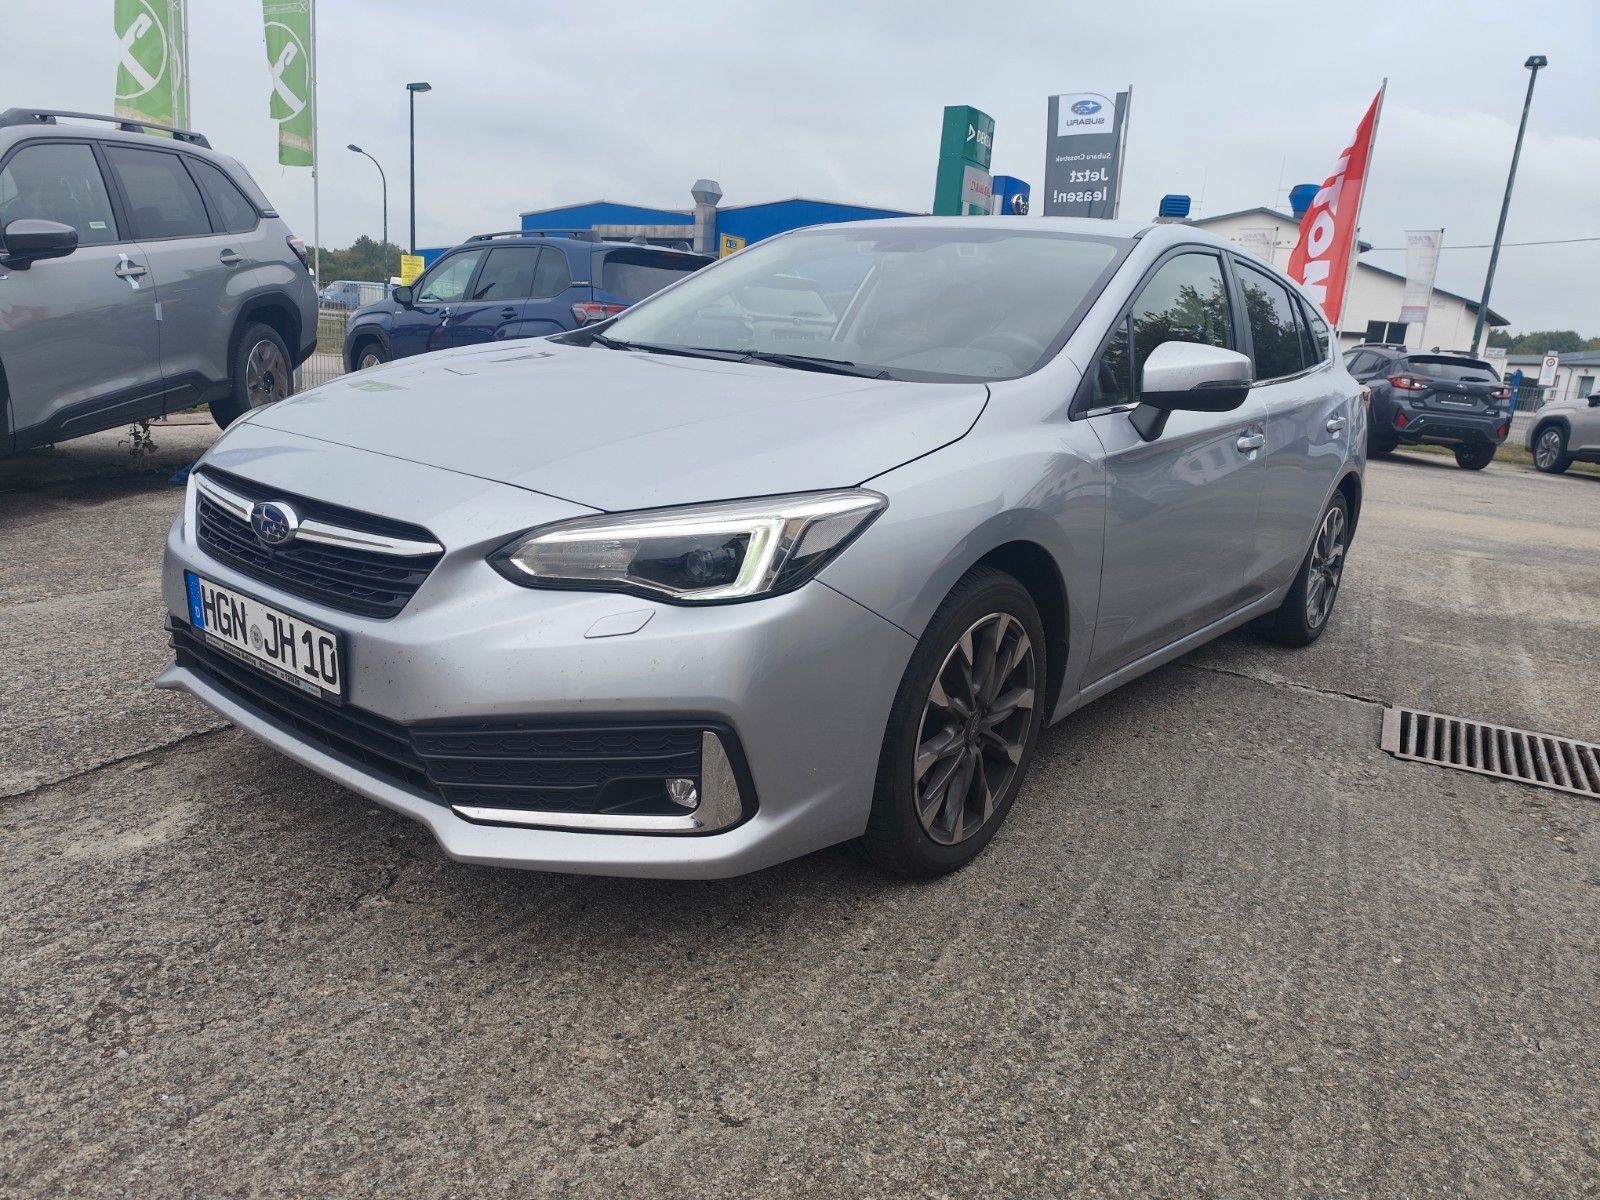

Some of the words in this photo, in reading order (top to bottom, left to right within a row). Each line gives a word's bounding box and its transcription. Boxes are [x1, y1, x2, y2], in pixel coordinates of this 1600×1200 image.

[200, 584, 248, 646] HGN
[264, 612, 297, 669] JH
[301, 629, 337, 686] 10
